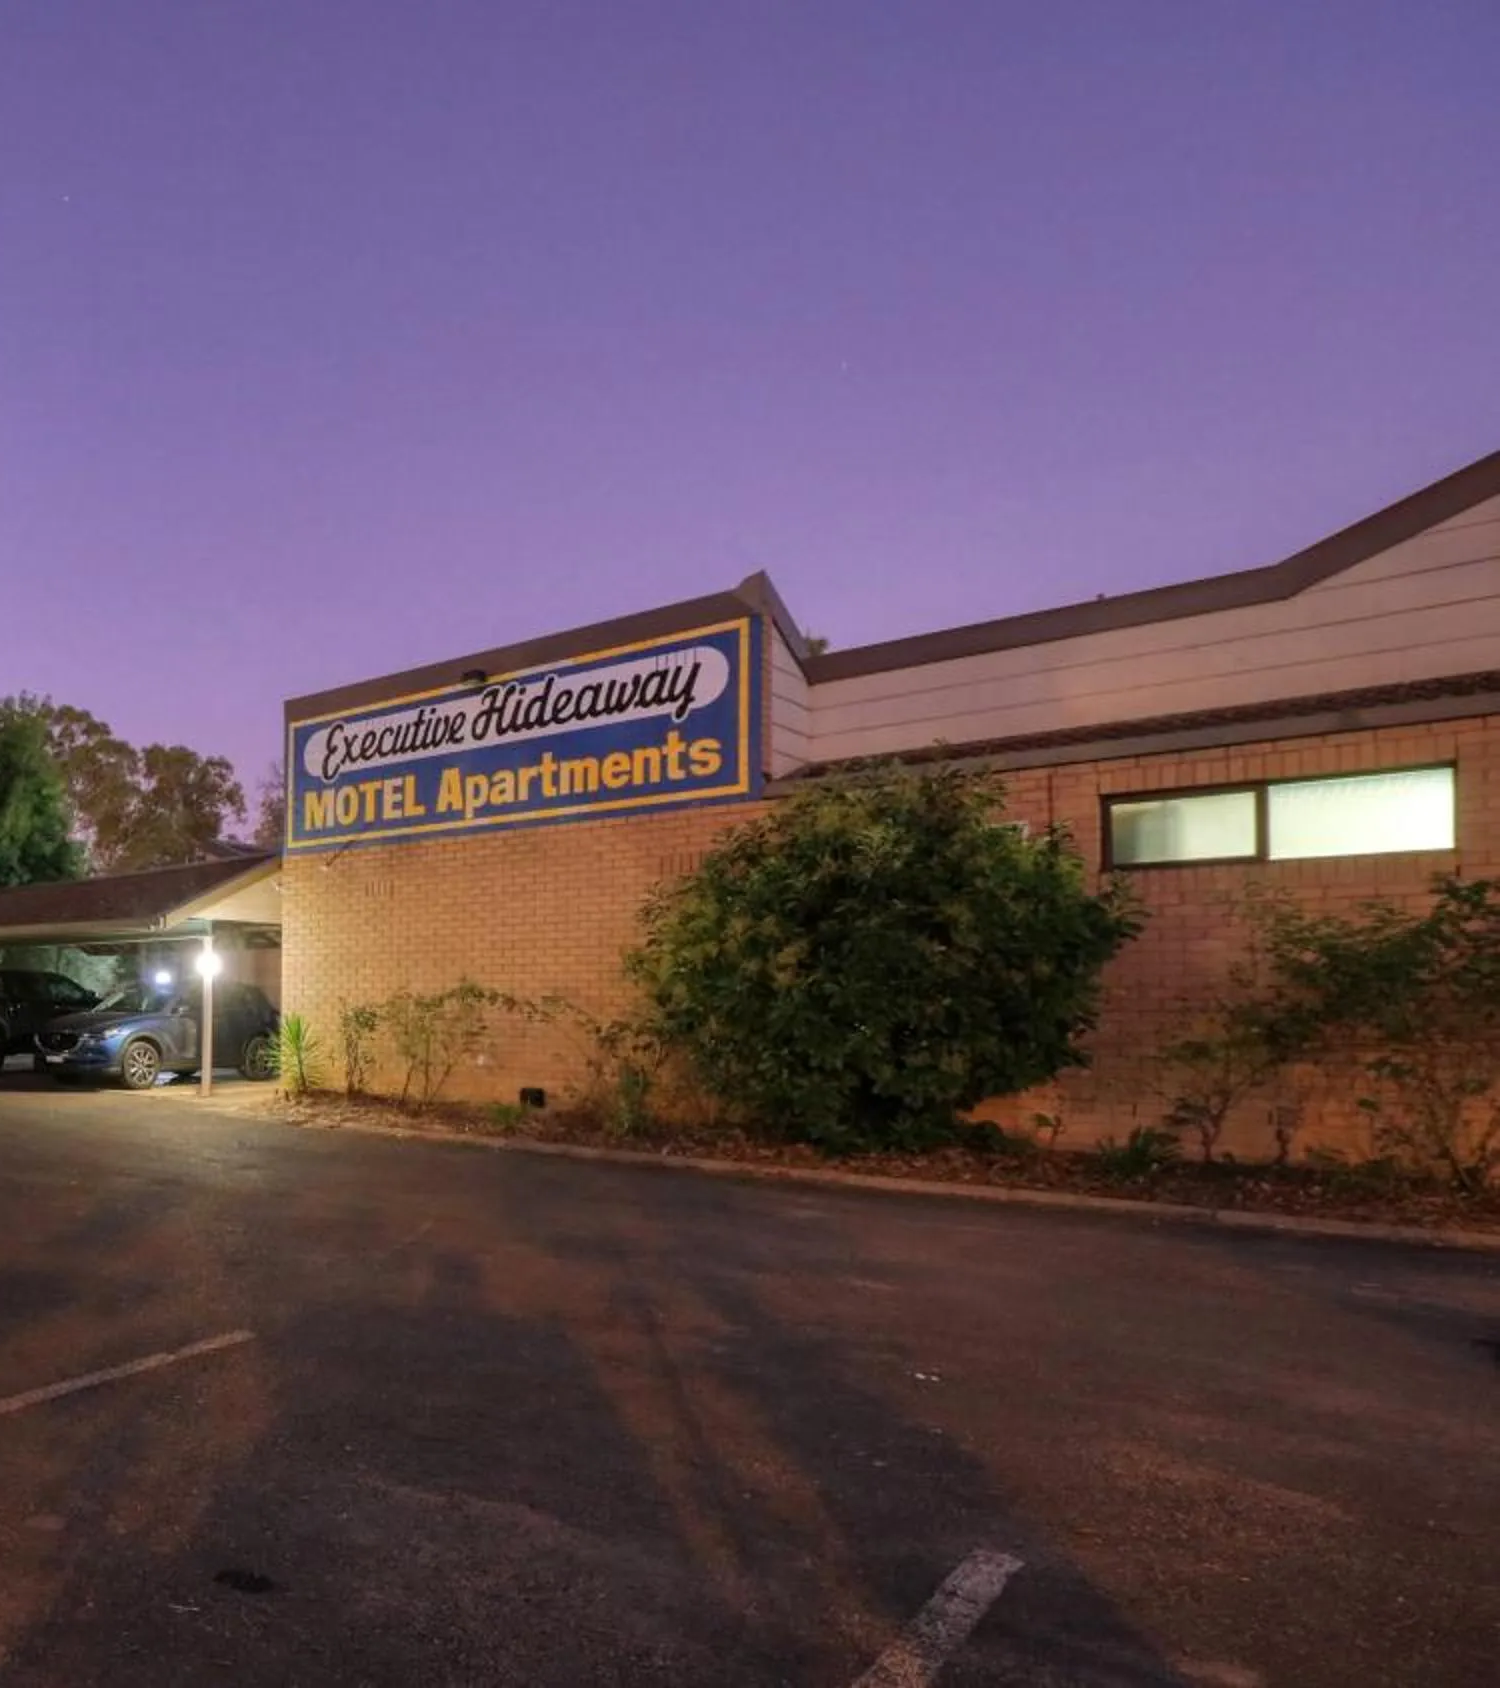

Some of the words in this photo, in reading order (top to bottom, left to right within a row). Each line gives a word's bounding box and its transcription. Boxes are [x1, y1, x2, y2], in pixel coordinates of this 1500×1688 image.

[321, 706, 466, 780] Executive
[471, 661, 701, 741] Hideaway
[304, 774, 425, 831] MOTEL
[437, 730, 722, 820] Apartments
